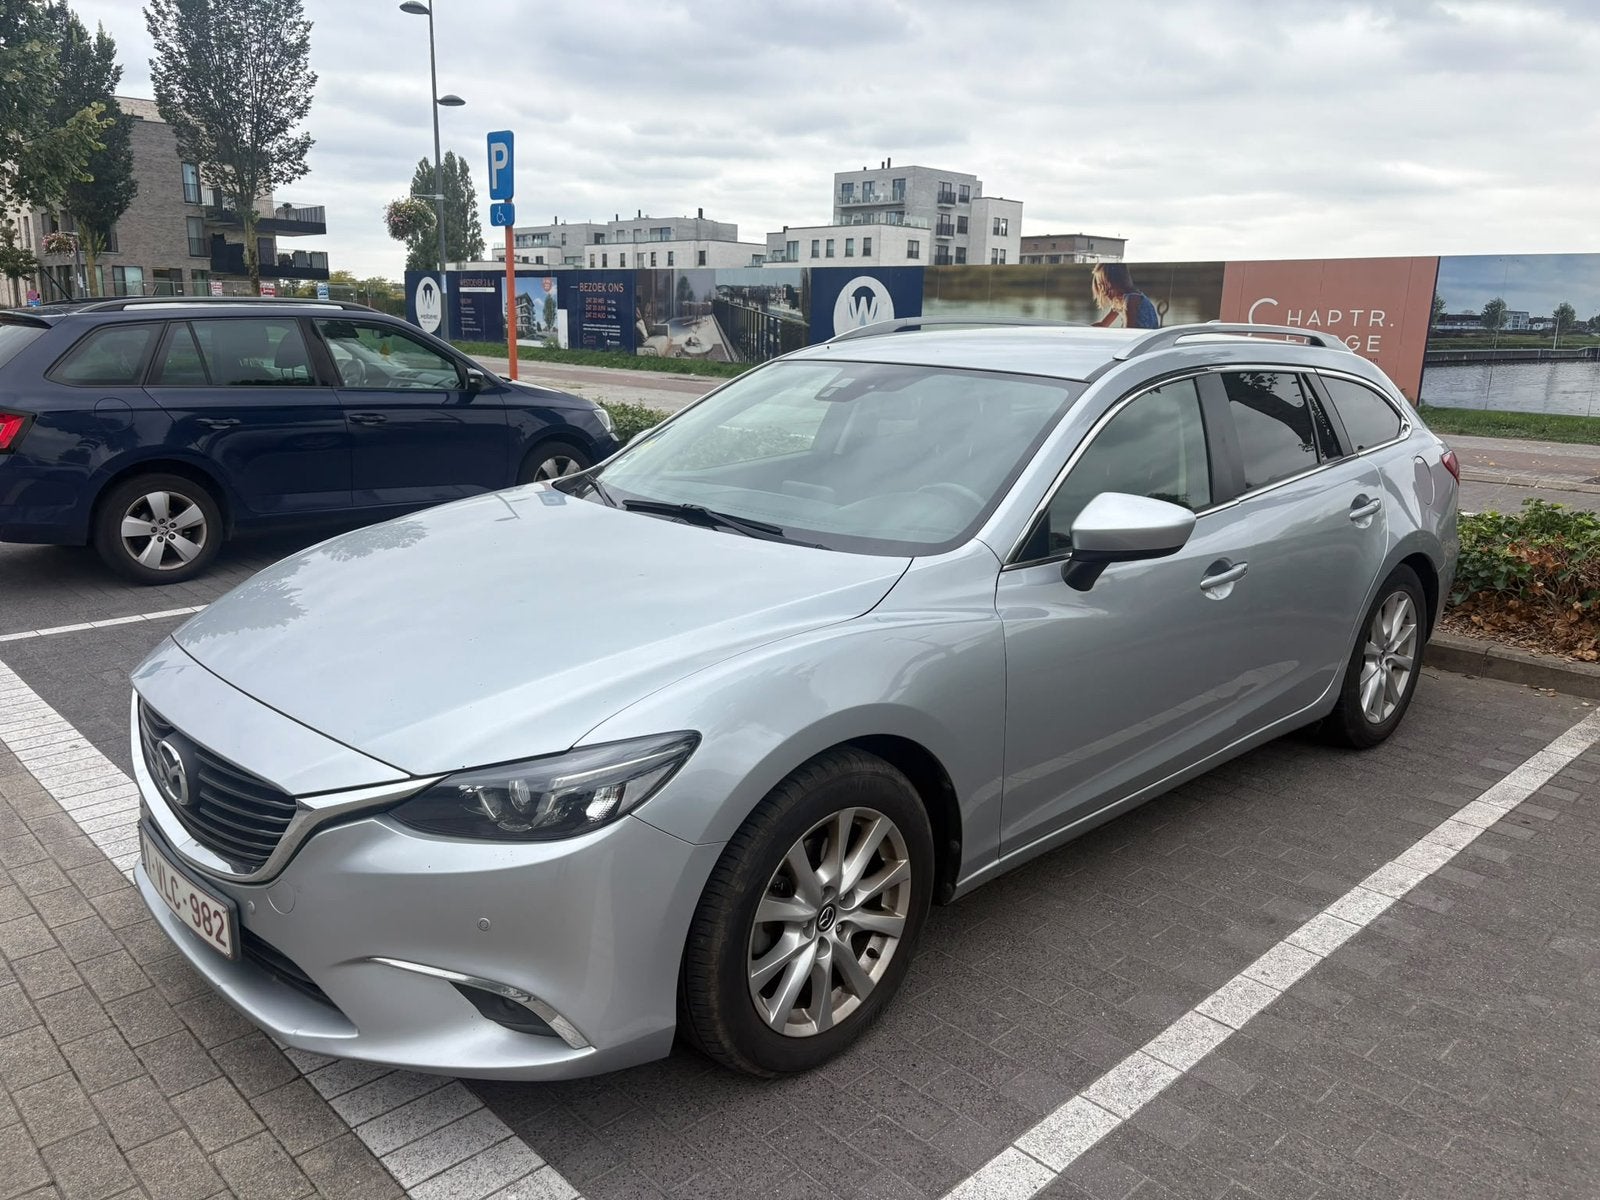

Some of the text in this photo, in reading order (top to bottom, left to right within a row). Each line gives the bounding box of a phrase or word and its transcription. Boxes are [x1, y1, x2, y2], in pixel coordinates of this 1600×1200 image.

[490, 142, 509, 190] P
[579, 282, 625, 293] BEZOEK ONS
